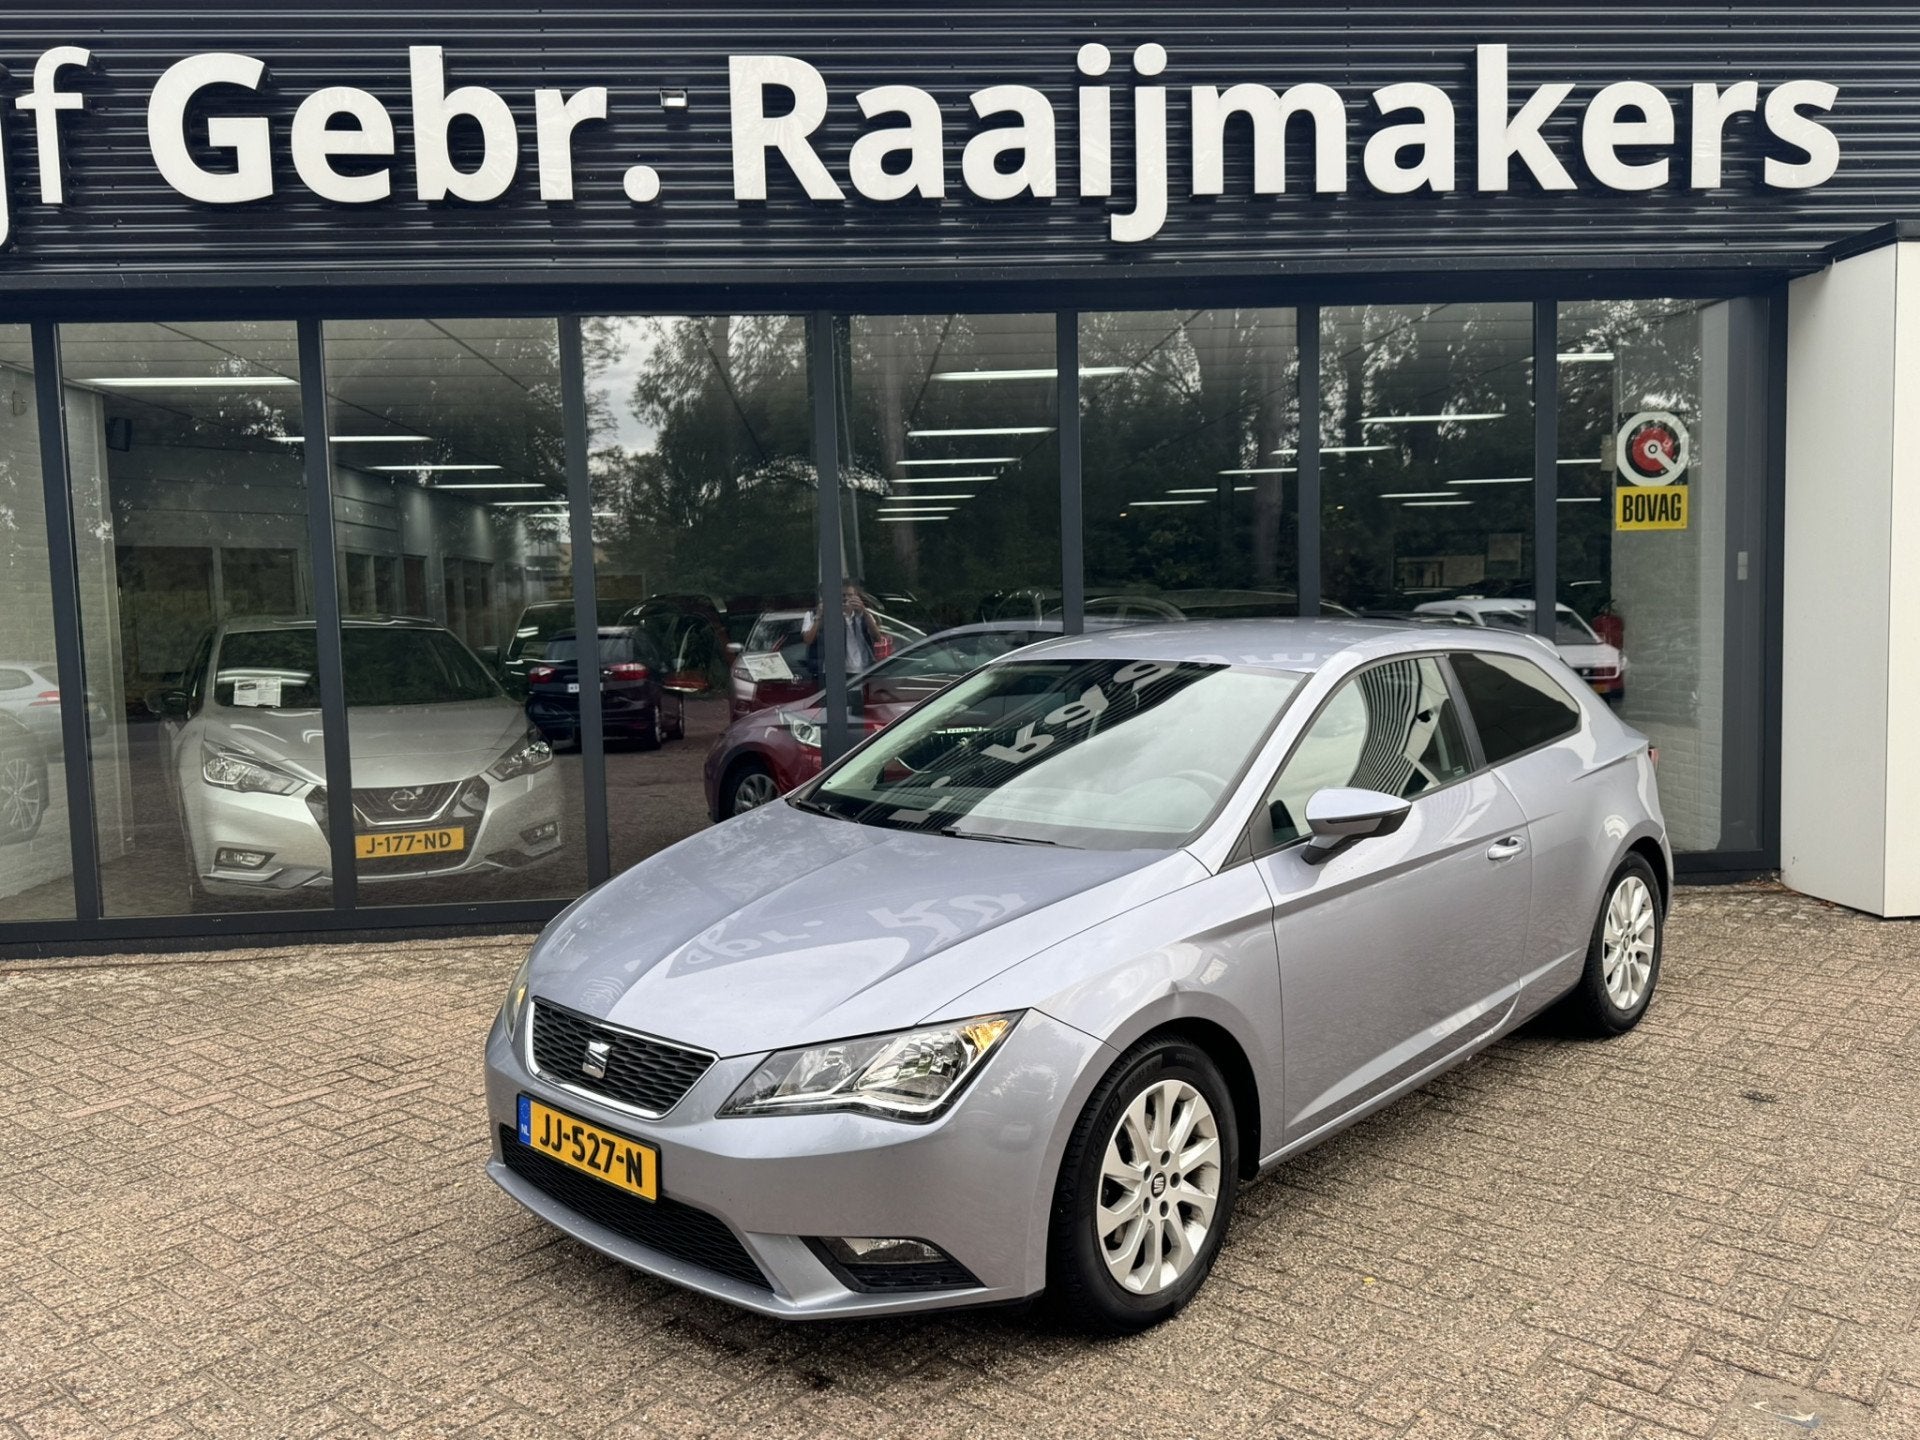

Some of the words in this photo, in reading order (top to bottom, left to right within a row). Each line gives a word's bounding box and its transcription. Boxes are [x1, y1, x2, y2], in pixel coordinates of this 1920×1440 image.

[147, 45, 661, 204] Gebr.
[729, 43, 1840, 243] Raaijmakers
[1622, 493, 1682, 523] BOVAG
[365, 831, 452, 854] J-177-ND
[520, 1123, 530, 1137] NL
[539, 1113, 643, 1188] JJ-527-N
